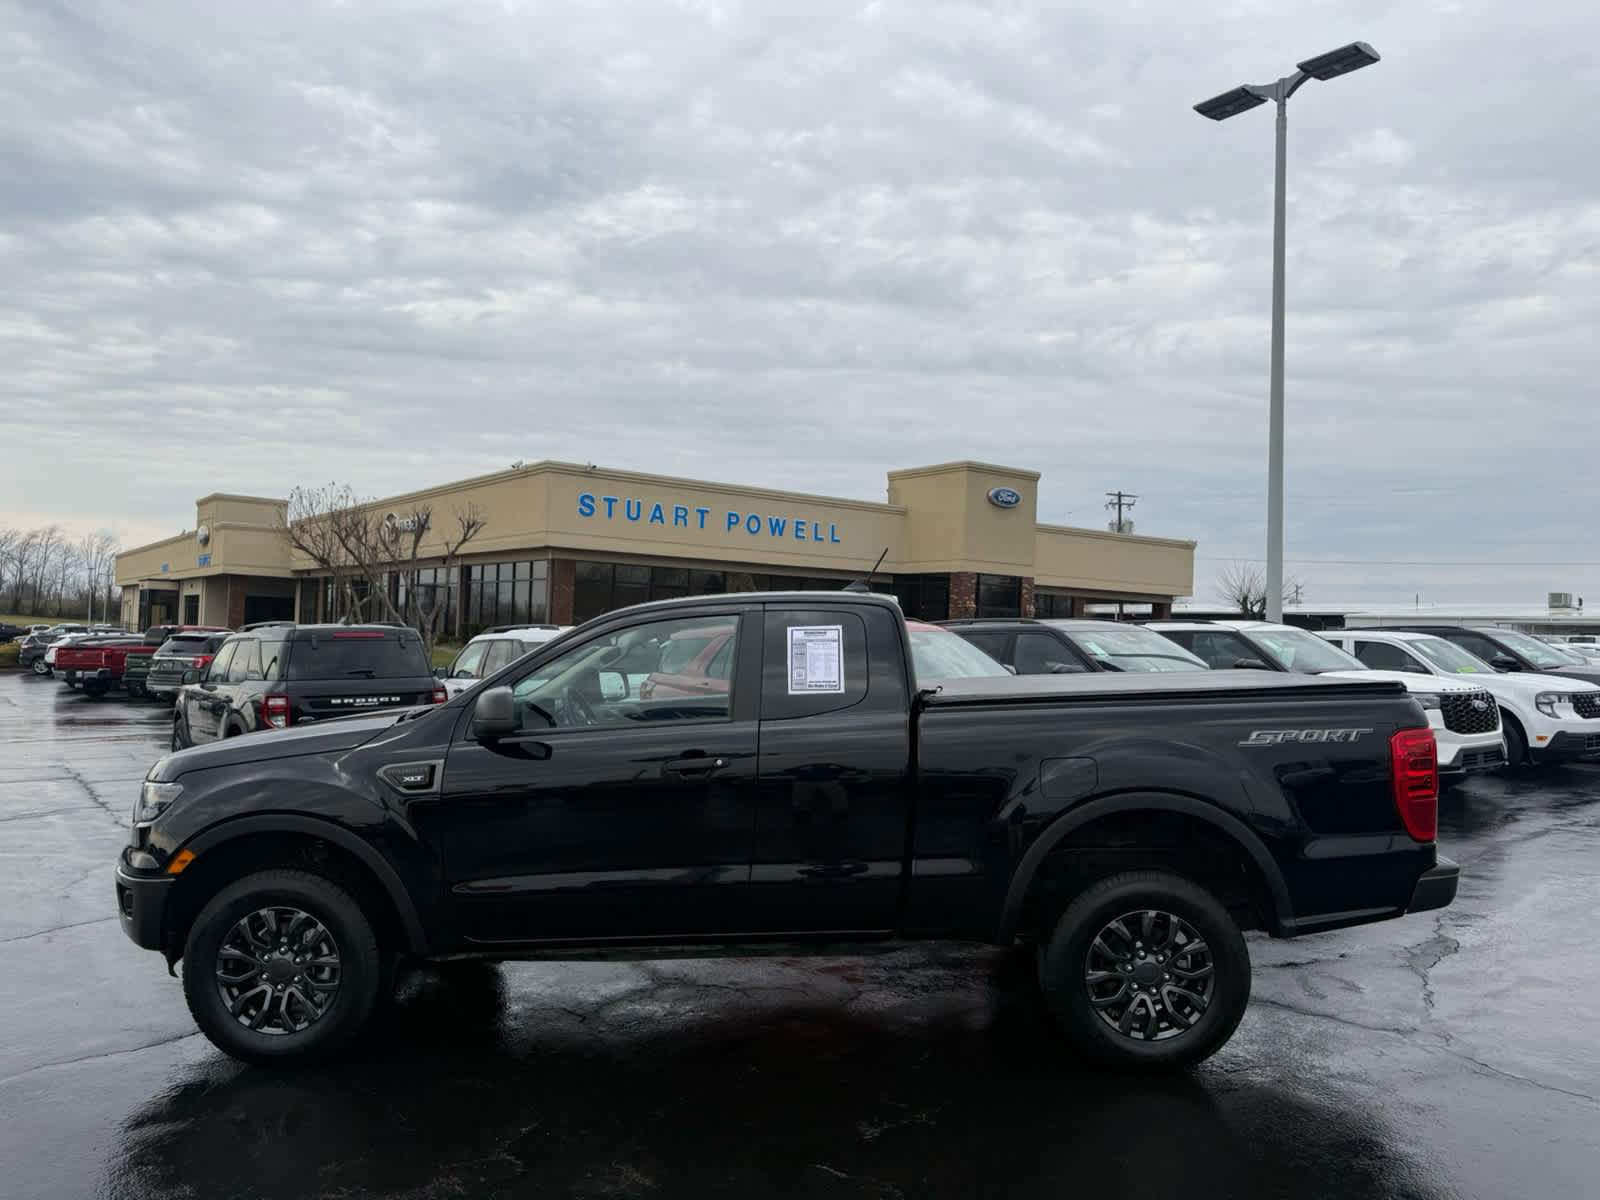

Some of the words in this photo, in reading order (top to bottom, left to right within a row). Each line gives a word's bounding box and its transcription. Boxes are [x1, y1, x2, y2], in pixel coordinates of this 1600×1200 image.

[577, 493, 710, 530] STUART
[725, 511, 842, 544] POWELL
[1237, 728, 1374, 747] SPORT
